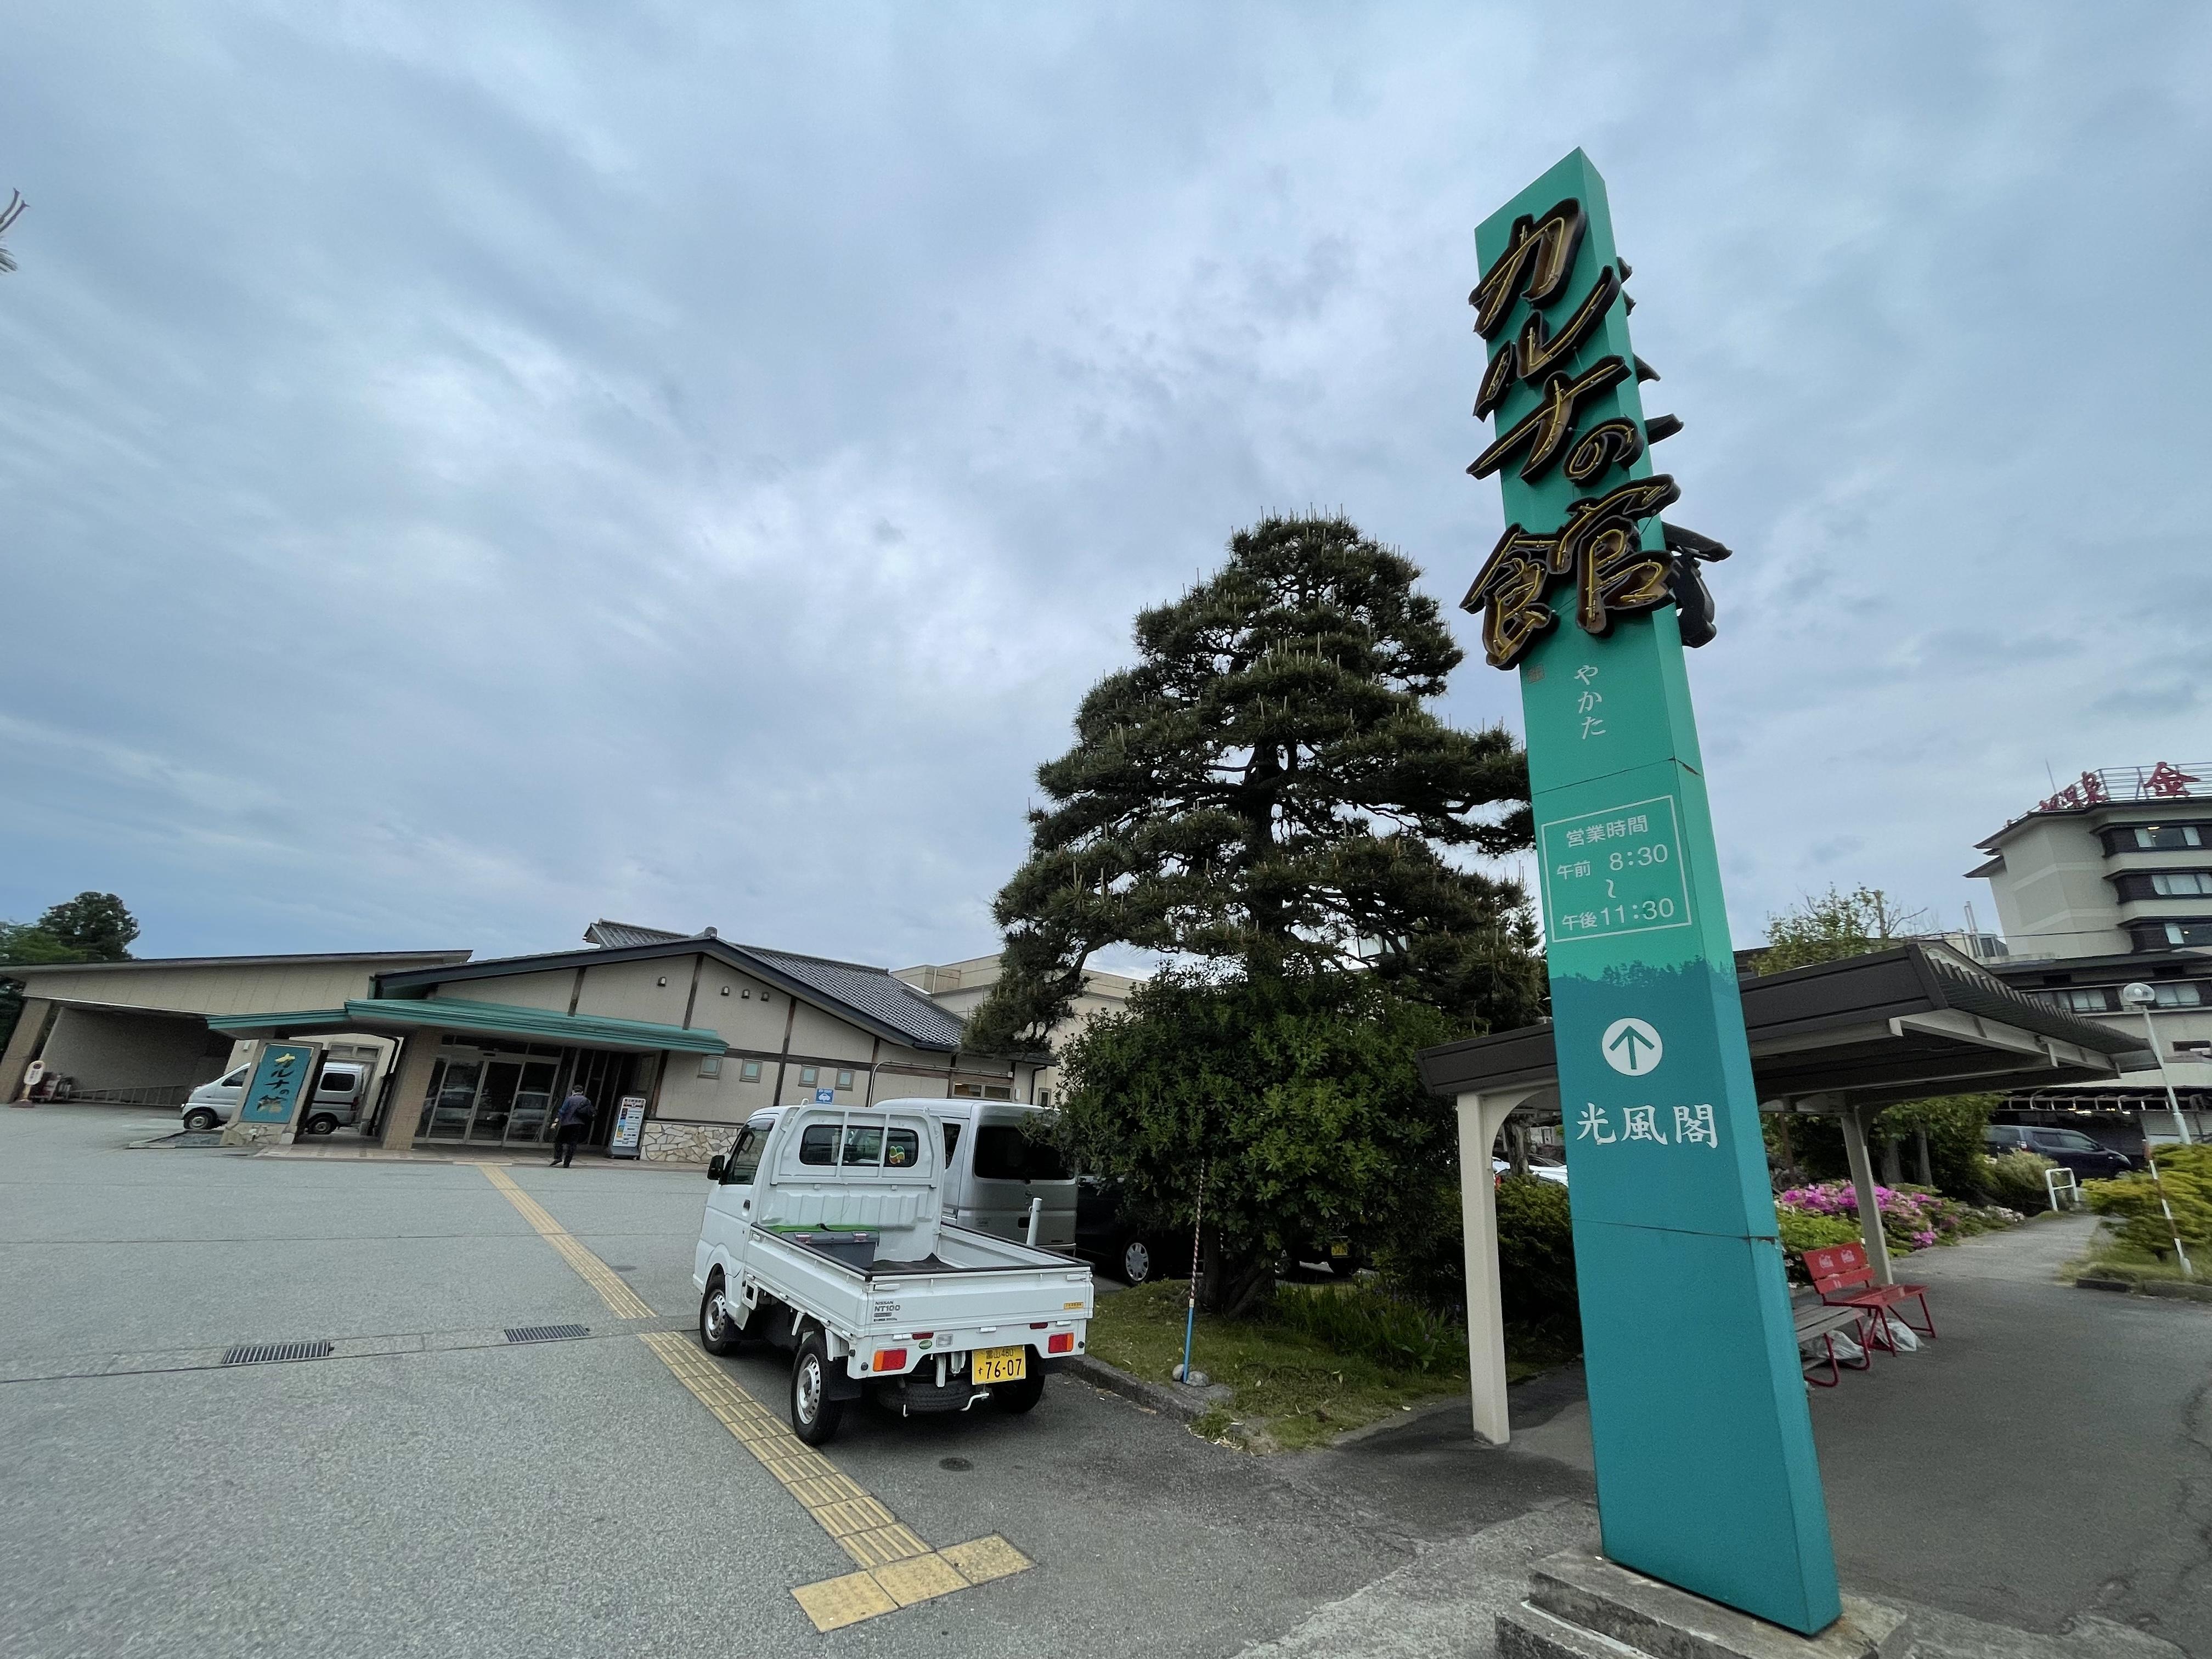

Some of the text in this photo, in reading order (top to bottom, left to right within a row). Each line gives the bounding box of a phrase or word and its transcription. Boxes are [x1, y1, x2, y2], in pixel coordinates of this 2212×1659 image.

[1460, 197, 1681, 670] カルナの館
[1574, 664, 1606, 740] やかた
[1566, 814, 1648, 849] 営業時間
[1557, 844, 1668, 881] 午前 8:30
[1562, 898, 1674, 932] 午後 11:30
[1576, 1102, 1718, 1149] 光風閣
[985, 1358, 1022, 1379] 76-07
